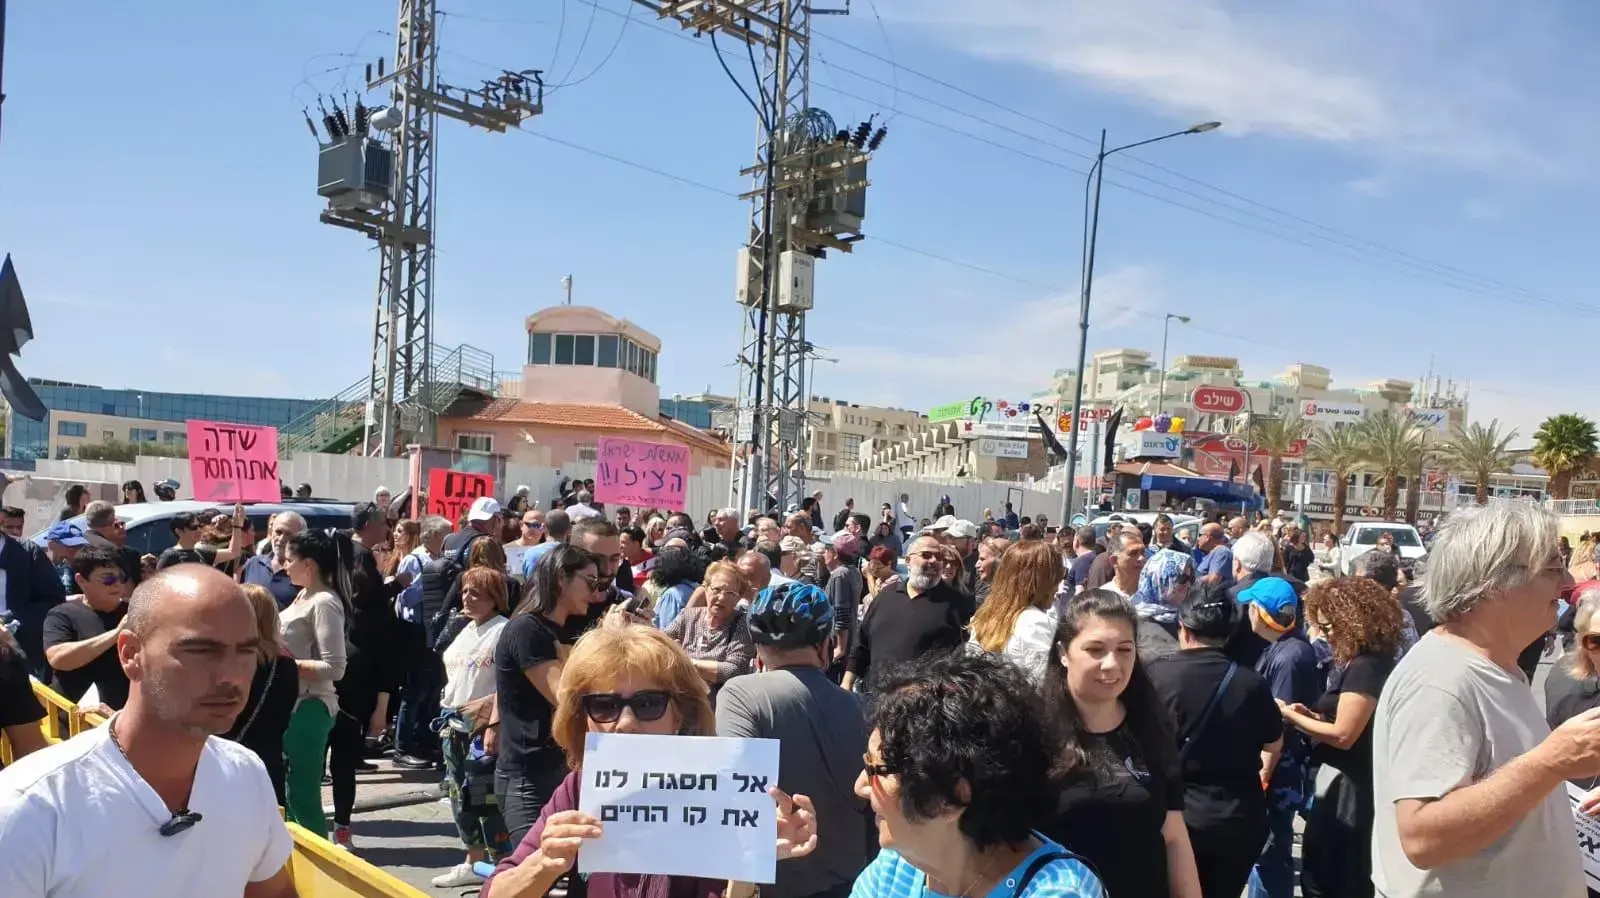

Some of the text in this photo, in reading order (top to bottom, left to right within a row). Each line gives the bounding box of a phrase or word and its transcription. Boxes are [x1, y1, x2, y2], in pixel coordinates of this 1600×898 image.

[1203, 392, 1235, 406] שילב
[203, 427, 257, 452] שדה
[194, 456, 277, 480] אתה חסר
[445, 473, 486, 498] תנו
[595, 769, 768, 793] אל תסגרו לנו
[601, 804, 759, 828] את קו החיים
